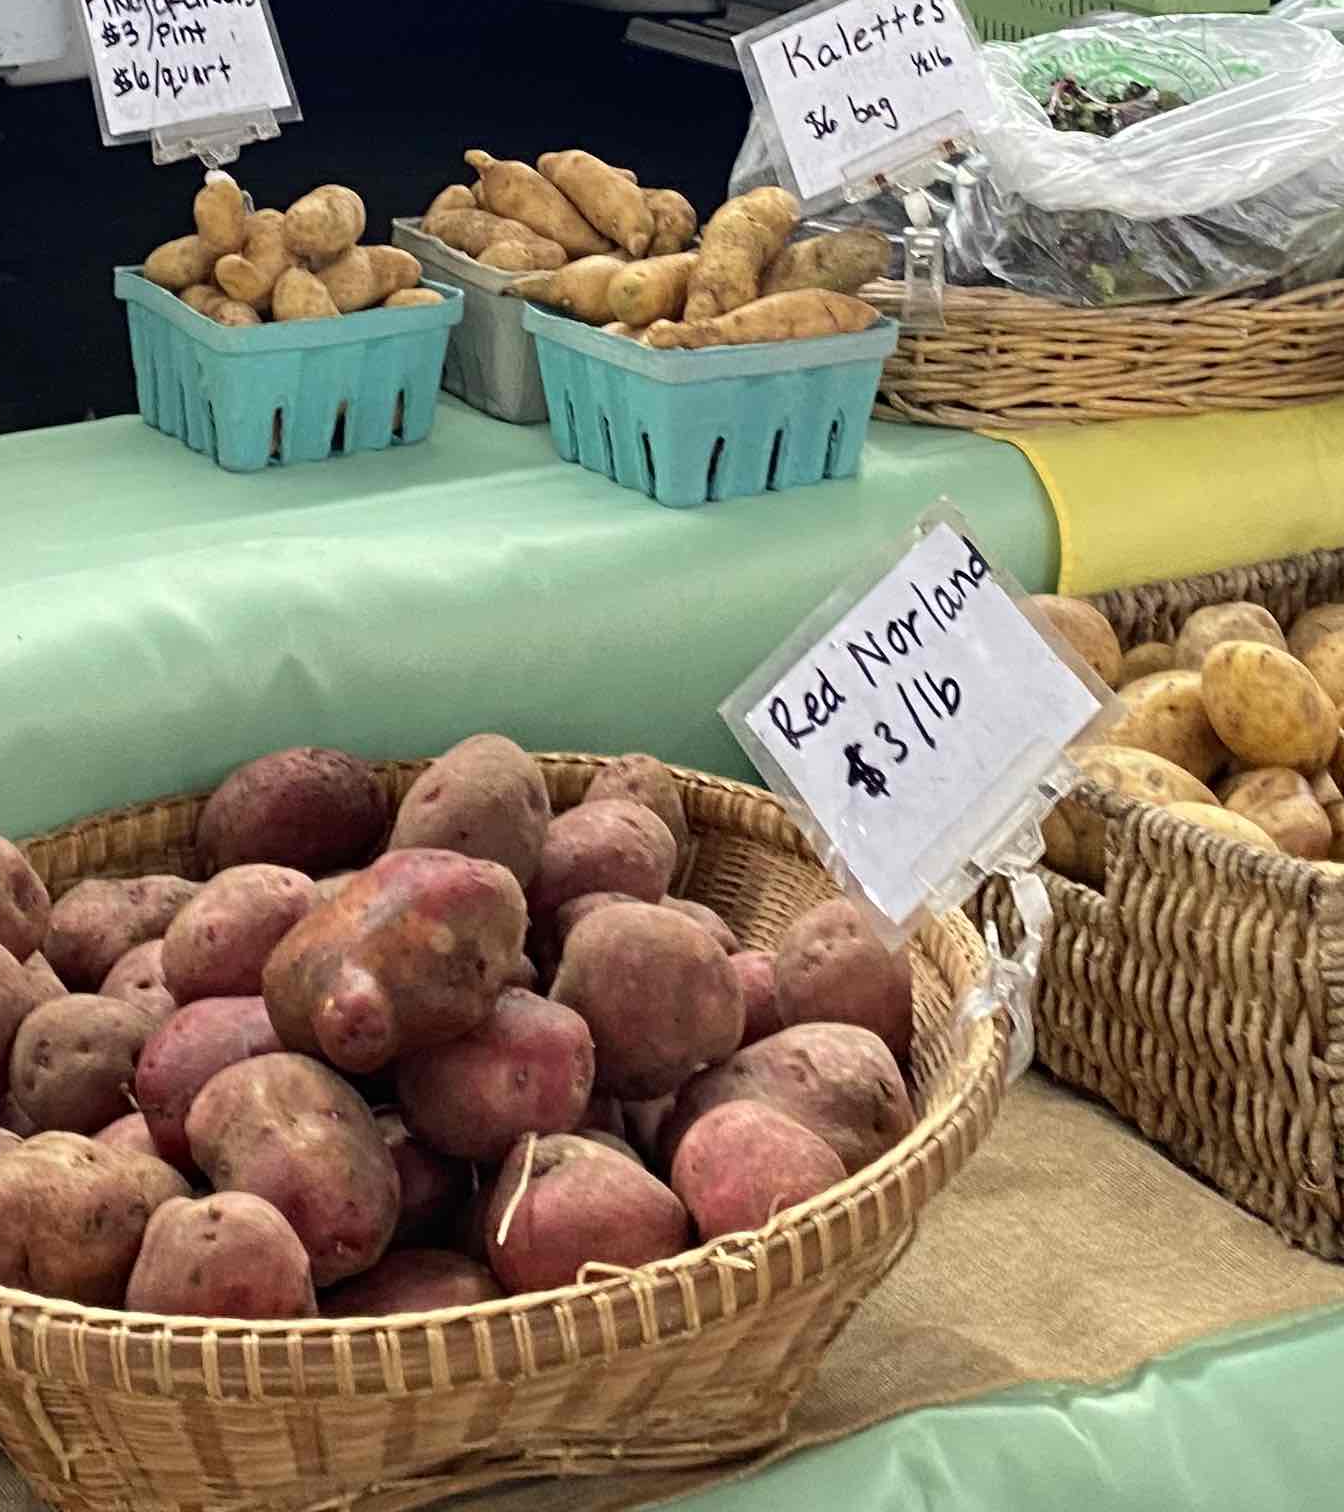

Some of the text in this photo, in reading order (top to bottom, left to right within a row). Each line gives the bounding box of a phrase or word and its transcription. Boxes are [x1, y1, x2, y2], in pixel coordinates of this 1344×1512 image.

[804, 94, 898, 140] $6 bag
[768, 535, 992, 750] Red Norland
